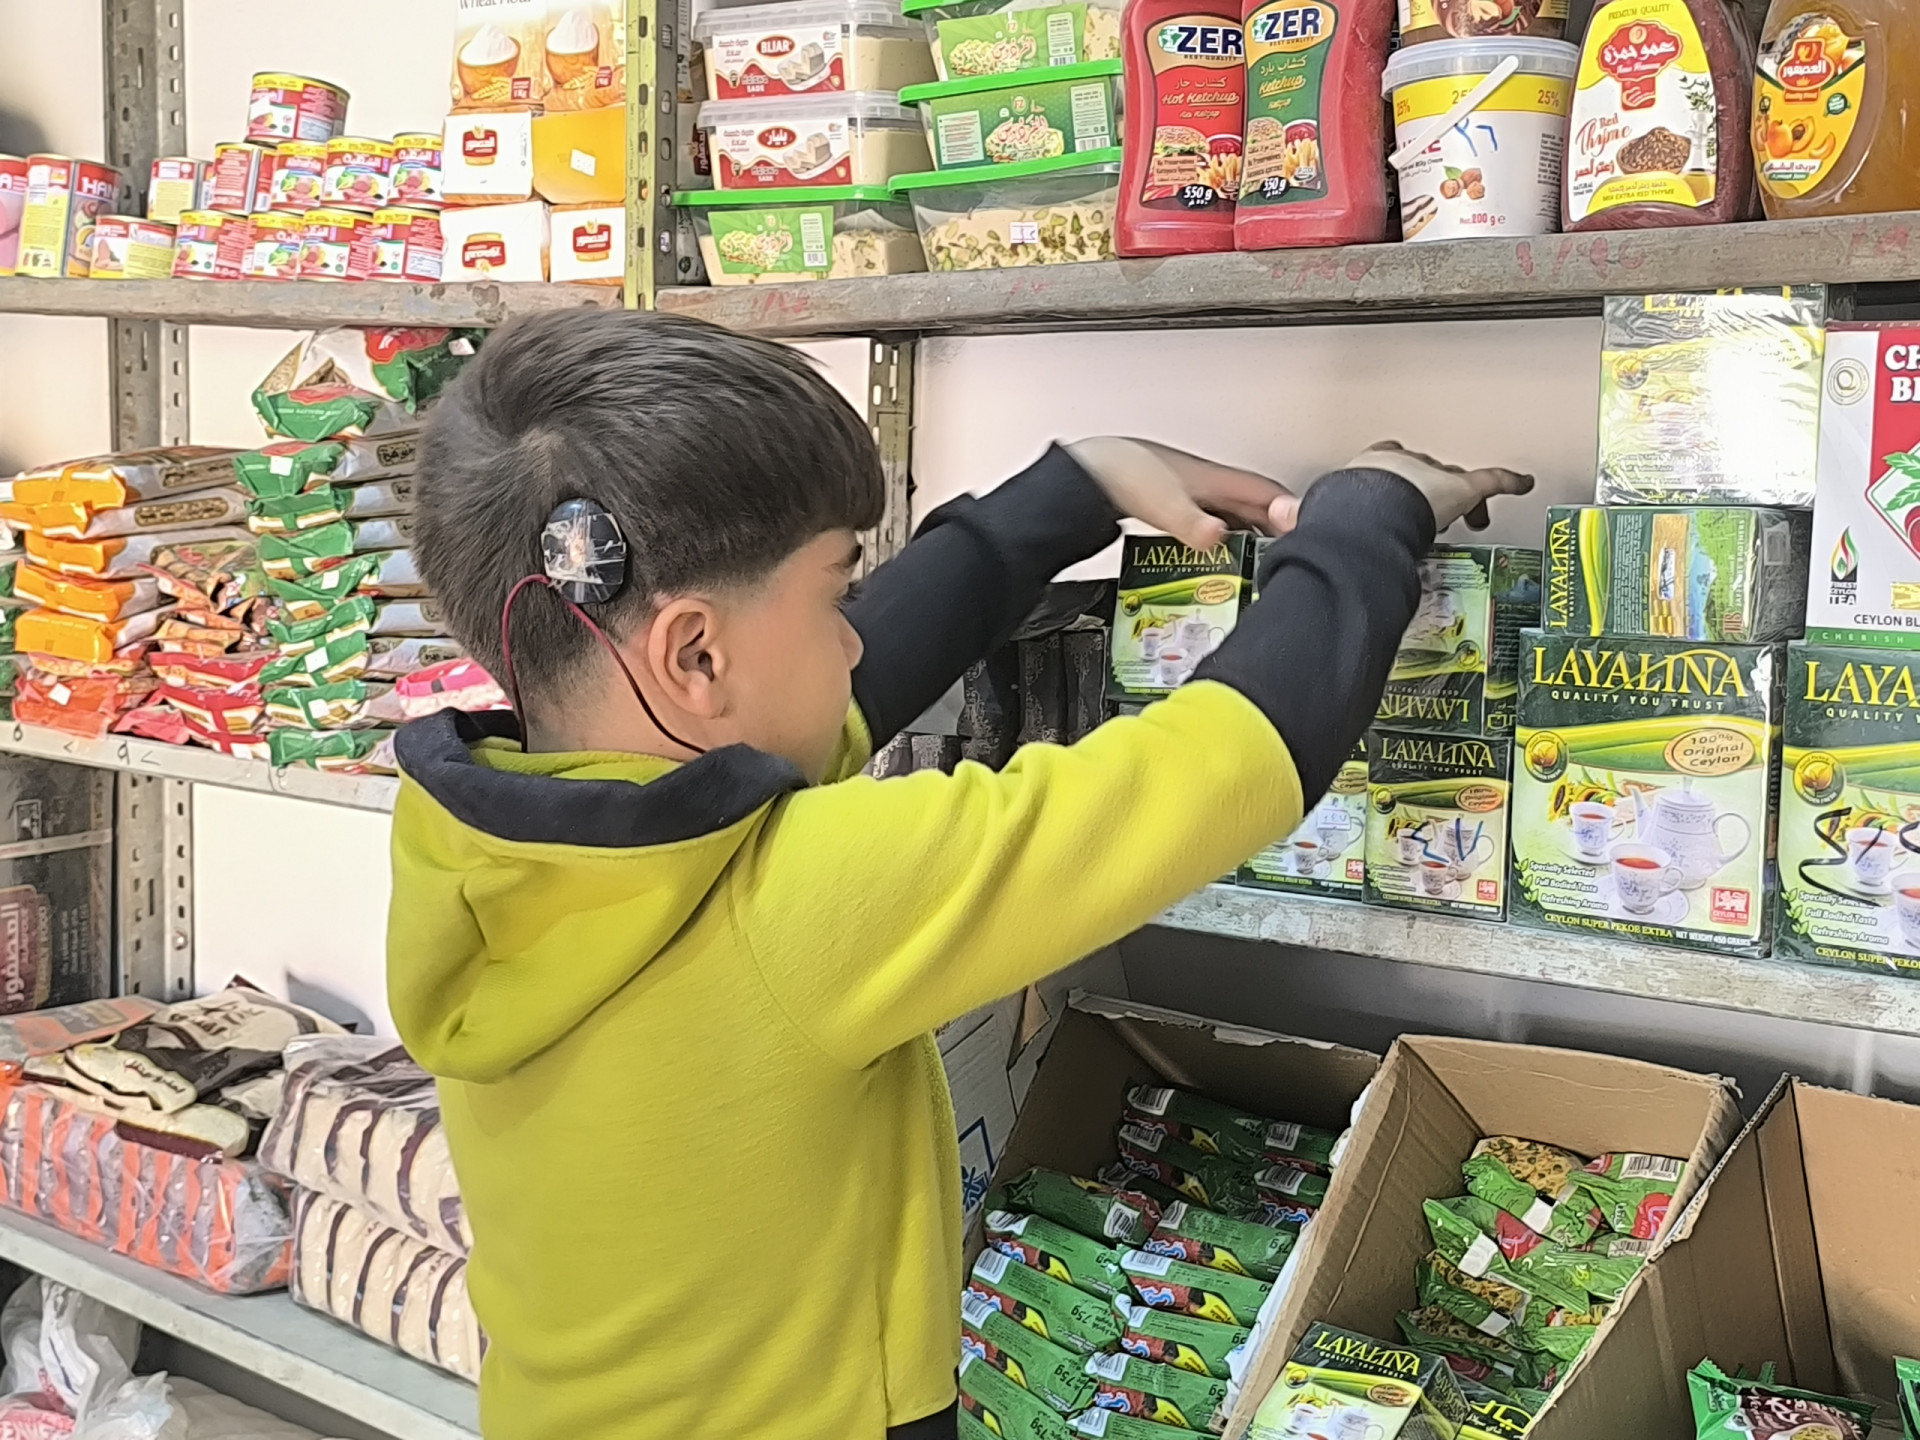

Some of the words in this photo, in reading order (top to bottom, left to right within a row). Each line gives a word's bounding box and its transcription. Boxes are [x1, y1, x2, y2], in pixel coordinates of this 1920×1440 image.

[1608, 9, 1637, 20] PREMIUM
[1641, 4, 1670, 15] QUALITY
[1265, 8, 1320, 40] ZER
[760, 40, 790, 53] BLIAR
[1177, 27, 1242, 54] ZER
[1604, 45, 1637, 65] حمزة
[1639, 40, 1675, 61] عمو
[1783, 60, 1827, 77] العصفور
[1176, 79, 1191, 89] حار
[1259, 75, 1306, 98] Ketchup
[1162, 93, 1184, 105] Hot
[1186, 91, 1239, 106] Ketchup
[1452, 88, 1474, 104] 25
[1538, 89, 1559, 107] 25%
[1600, 113, 1619, 129] Red
[1575, 118, 1632, 157] Thyme
[1263, 179, 1279, 191] 550
[1279, 179, 1286, 191] g
[1184, 187, 1203, 199] 550
[1205, 190, 1212, 200] g
[1615, 192, 1635, 200] EXTRA
[1651, 189, 1674, 197] THYME
[1472, 213, 1487, 223] 200
[1133, 543, 1231, 566] LAYALINA
[1550, 518, 1570, 628] LAYALINA
[1830, 595, 1856, 605] TEA
[1854, 614, 1902, 626] CEYLON
[1822, 632, 1904, 643] CHERISH
[1532, 647, 1749, 697] LAYALINA
[1375, 693, 1470, 722] LAYALIN
[1551, 690, 1618, 703] QUALITY
[1630, 696, 1660, 706] YOU
[1671, 699, 1724, 711] TRUST
[1826, 707, 1903, 722] QUALITY
[1691, 733, 1734, 745] 100%
[1381, 738, 1496, 769] LAYALINA
[1683, 743, 1744, 756] Original
[1392, 762, 1428, 770] QUALITY
[1455, 768, 1483, 776] TRUST
[1690, 755, 1741, 767] Ceylon
[1530, 862, 1562, 876] Specially
[1563, 866, 1595, 877] Selected
[1535, 878, 1549, 888] Full
[1550, 880, 1577, 891] Bodied
[1578, 883, 1598, 893] Taste
[1541, 894, 1581, 908] Refreshing
[1582, 900, 1608, 910] Aroma
[1799, 891, 1837, 904] Specially
[38, 906, 49, 943] FOOD
[1805, 909, 1822, 919] Full
[1823, 912, 1853, 922] Bodied
[1854, 916, 1877, 926] Taste
[1545, 913, 1579, 926] CEYLON
[1582, 918, 1610, 929] SUPER
[1611, 922, 1641, 934] PEKOE
[1642, 926, 1673, 938] EXTRA
[1675, 930, 1688, 940] NET
[1713, 934, 1727, 944] 450
[1811, 927, 1857, 942] Refreshing
[1858, 934, 1889, 945] Aroma
[0, 902, 26, 1002] العصفور
[1816, 948, 1857, 961] CEYLON
[1071, 1304, 1090, 1324] 75g
[1314, 1331, 1421, 1376] LAYALINA
[1054, 1363, 1074, 1387] 75g
[1209, 1385, 1225, 1400] 5g
[1030, 1417, 1051, 1440] 75g
